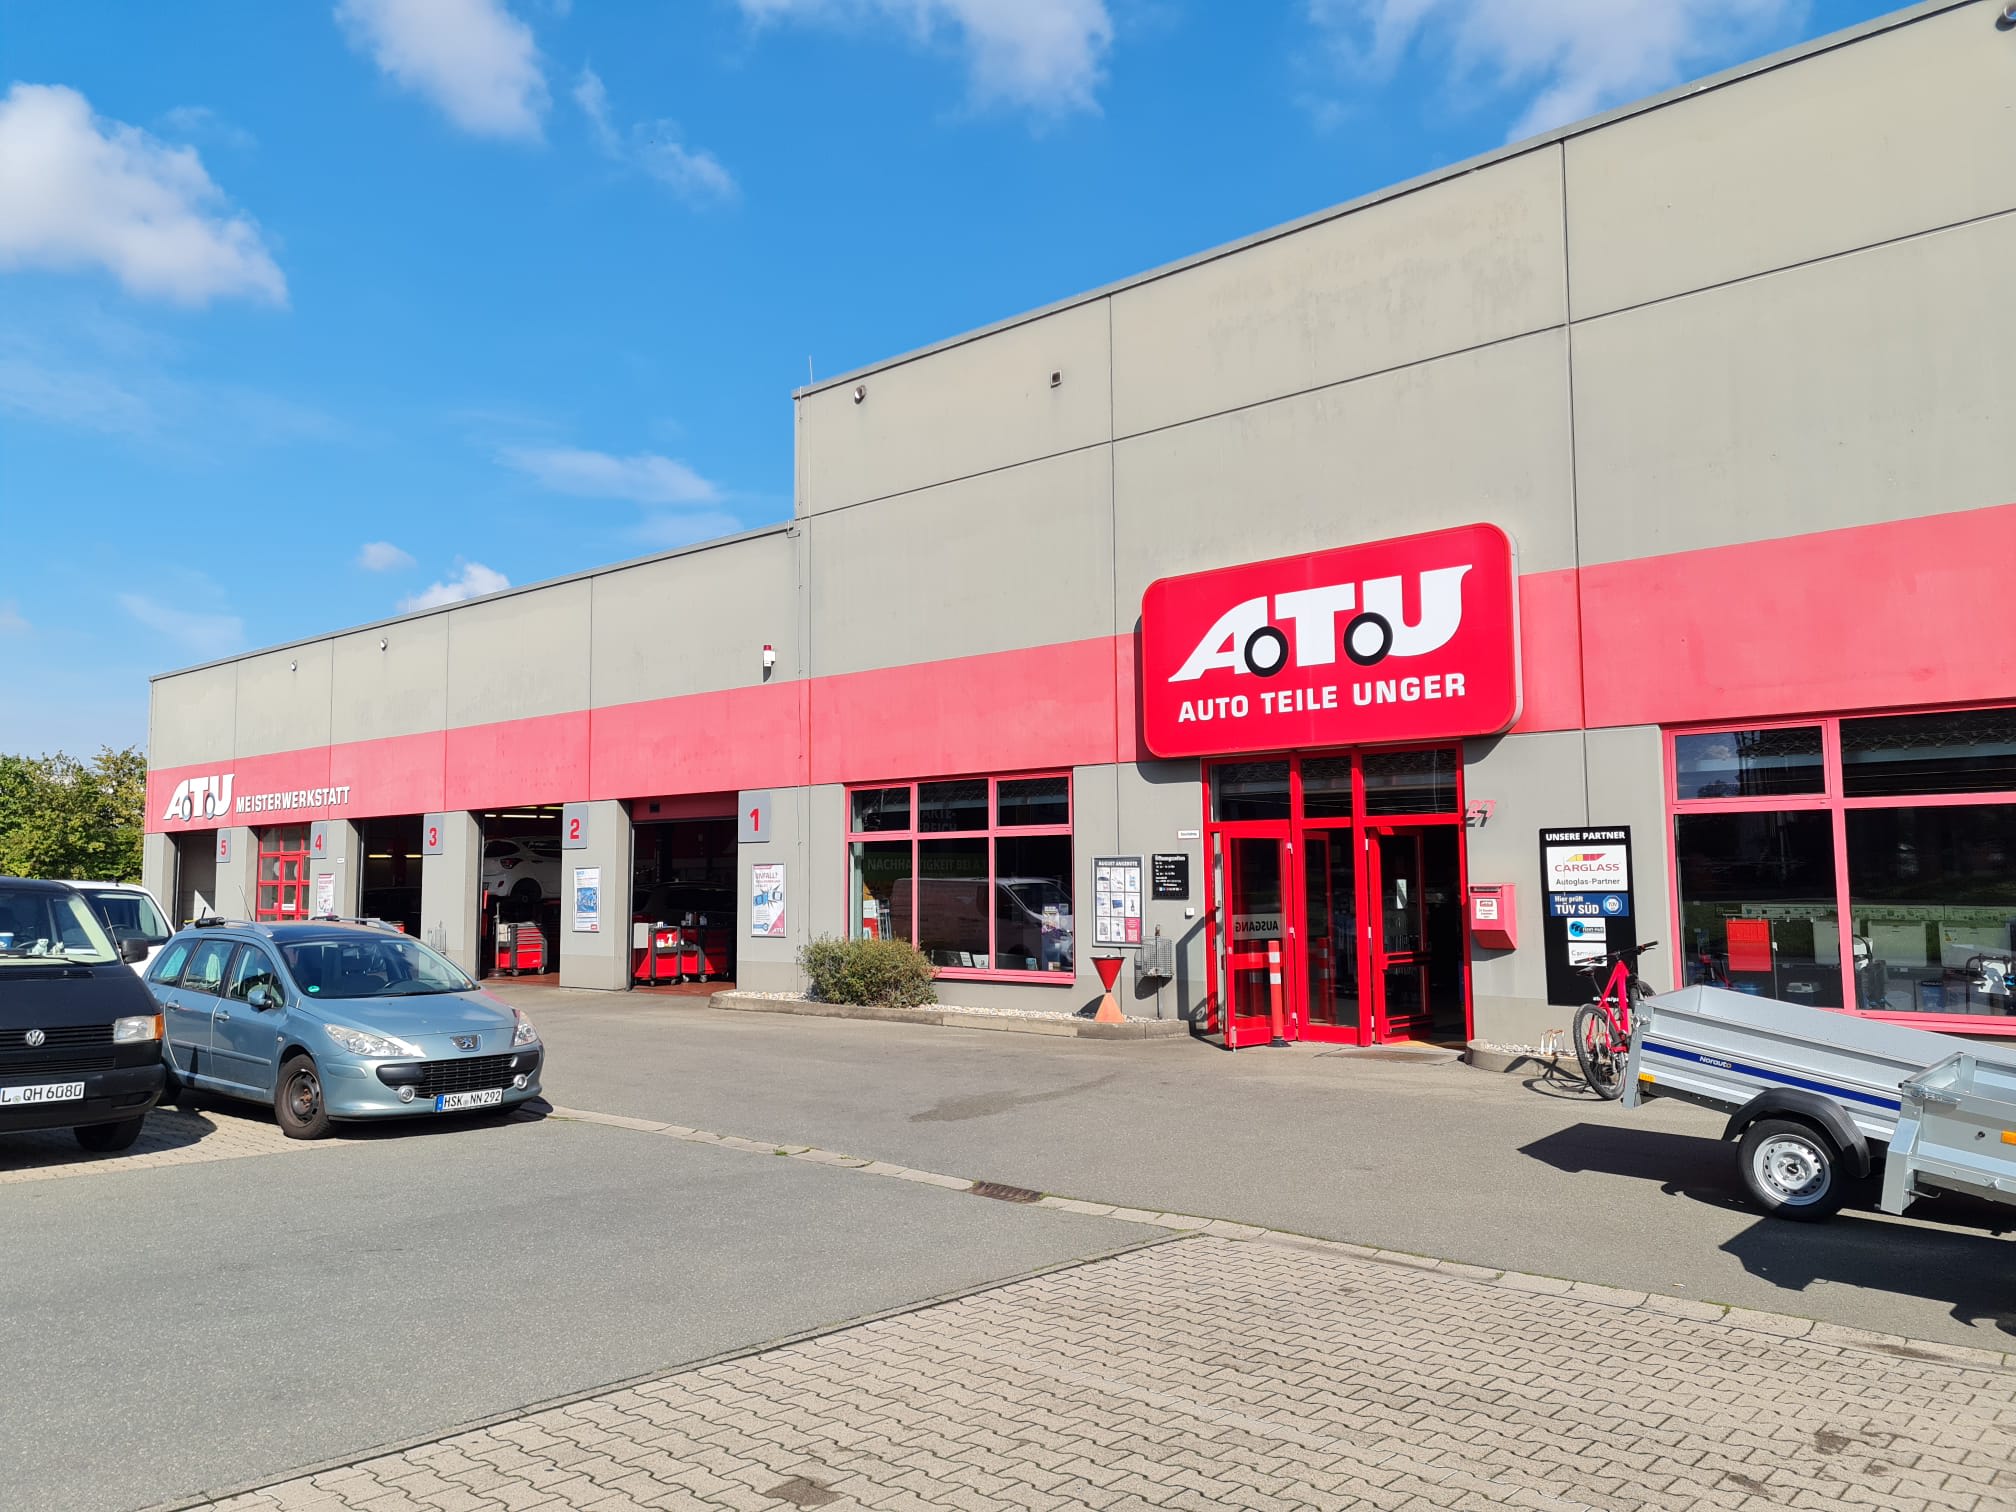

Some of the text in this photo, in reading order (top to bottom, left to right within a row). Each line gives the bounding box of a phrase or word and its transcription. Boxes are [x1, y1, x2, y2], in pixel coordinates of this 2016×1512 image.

[1168, 564, 1473, 683] ATU
[1178, 673, 1466, 723] AUTO TEILE UNGER
[163, 774, 350, 821] ATU MEISTERWERKSTATT
[749, 808, 759, 832] 1
[429, 827, 437, 846] 3
[569, 819, 580, 839] 2
[1546, 831, 1625, 841] UNSERE PARTNER
[220, 839, 227, 856] 5
[314, 834, 322, 851] 4
[867, 857, 954, 871] NACHHAIGKEIT
[1554, 863, 1620, 872] CARGLASS
[1556, 878, 1620, 886] Autoglas-Partner
[1555, 901, 1599, 914] TÜV SÜD
[1699, 1056, 1731, 1068] Norauto
[2, 1084, 82, 1103] L QH 6080
[444, 1090, 500, 1108] HSK NN 292
